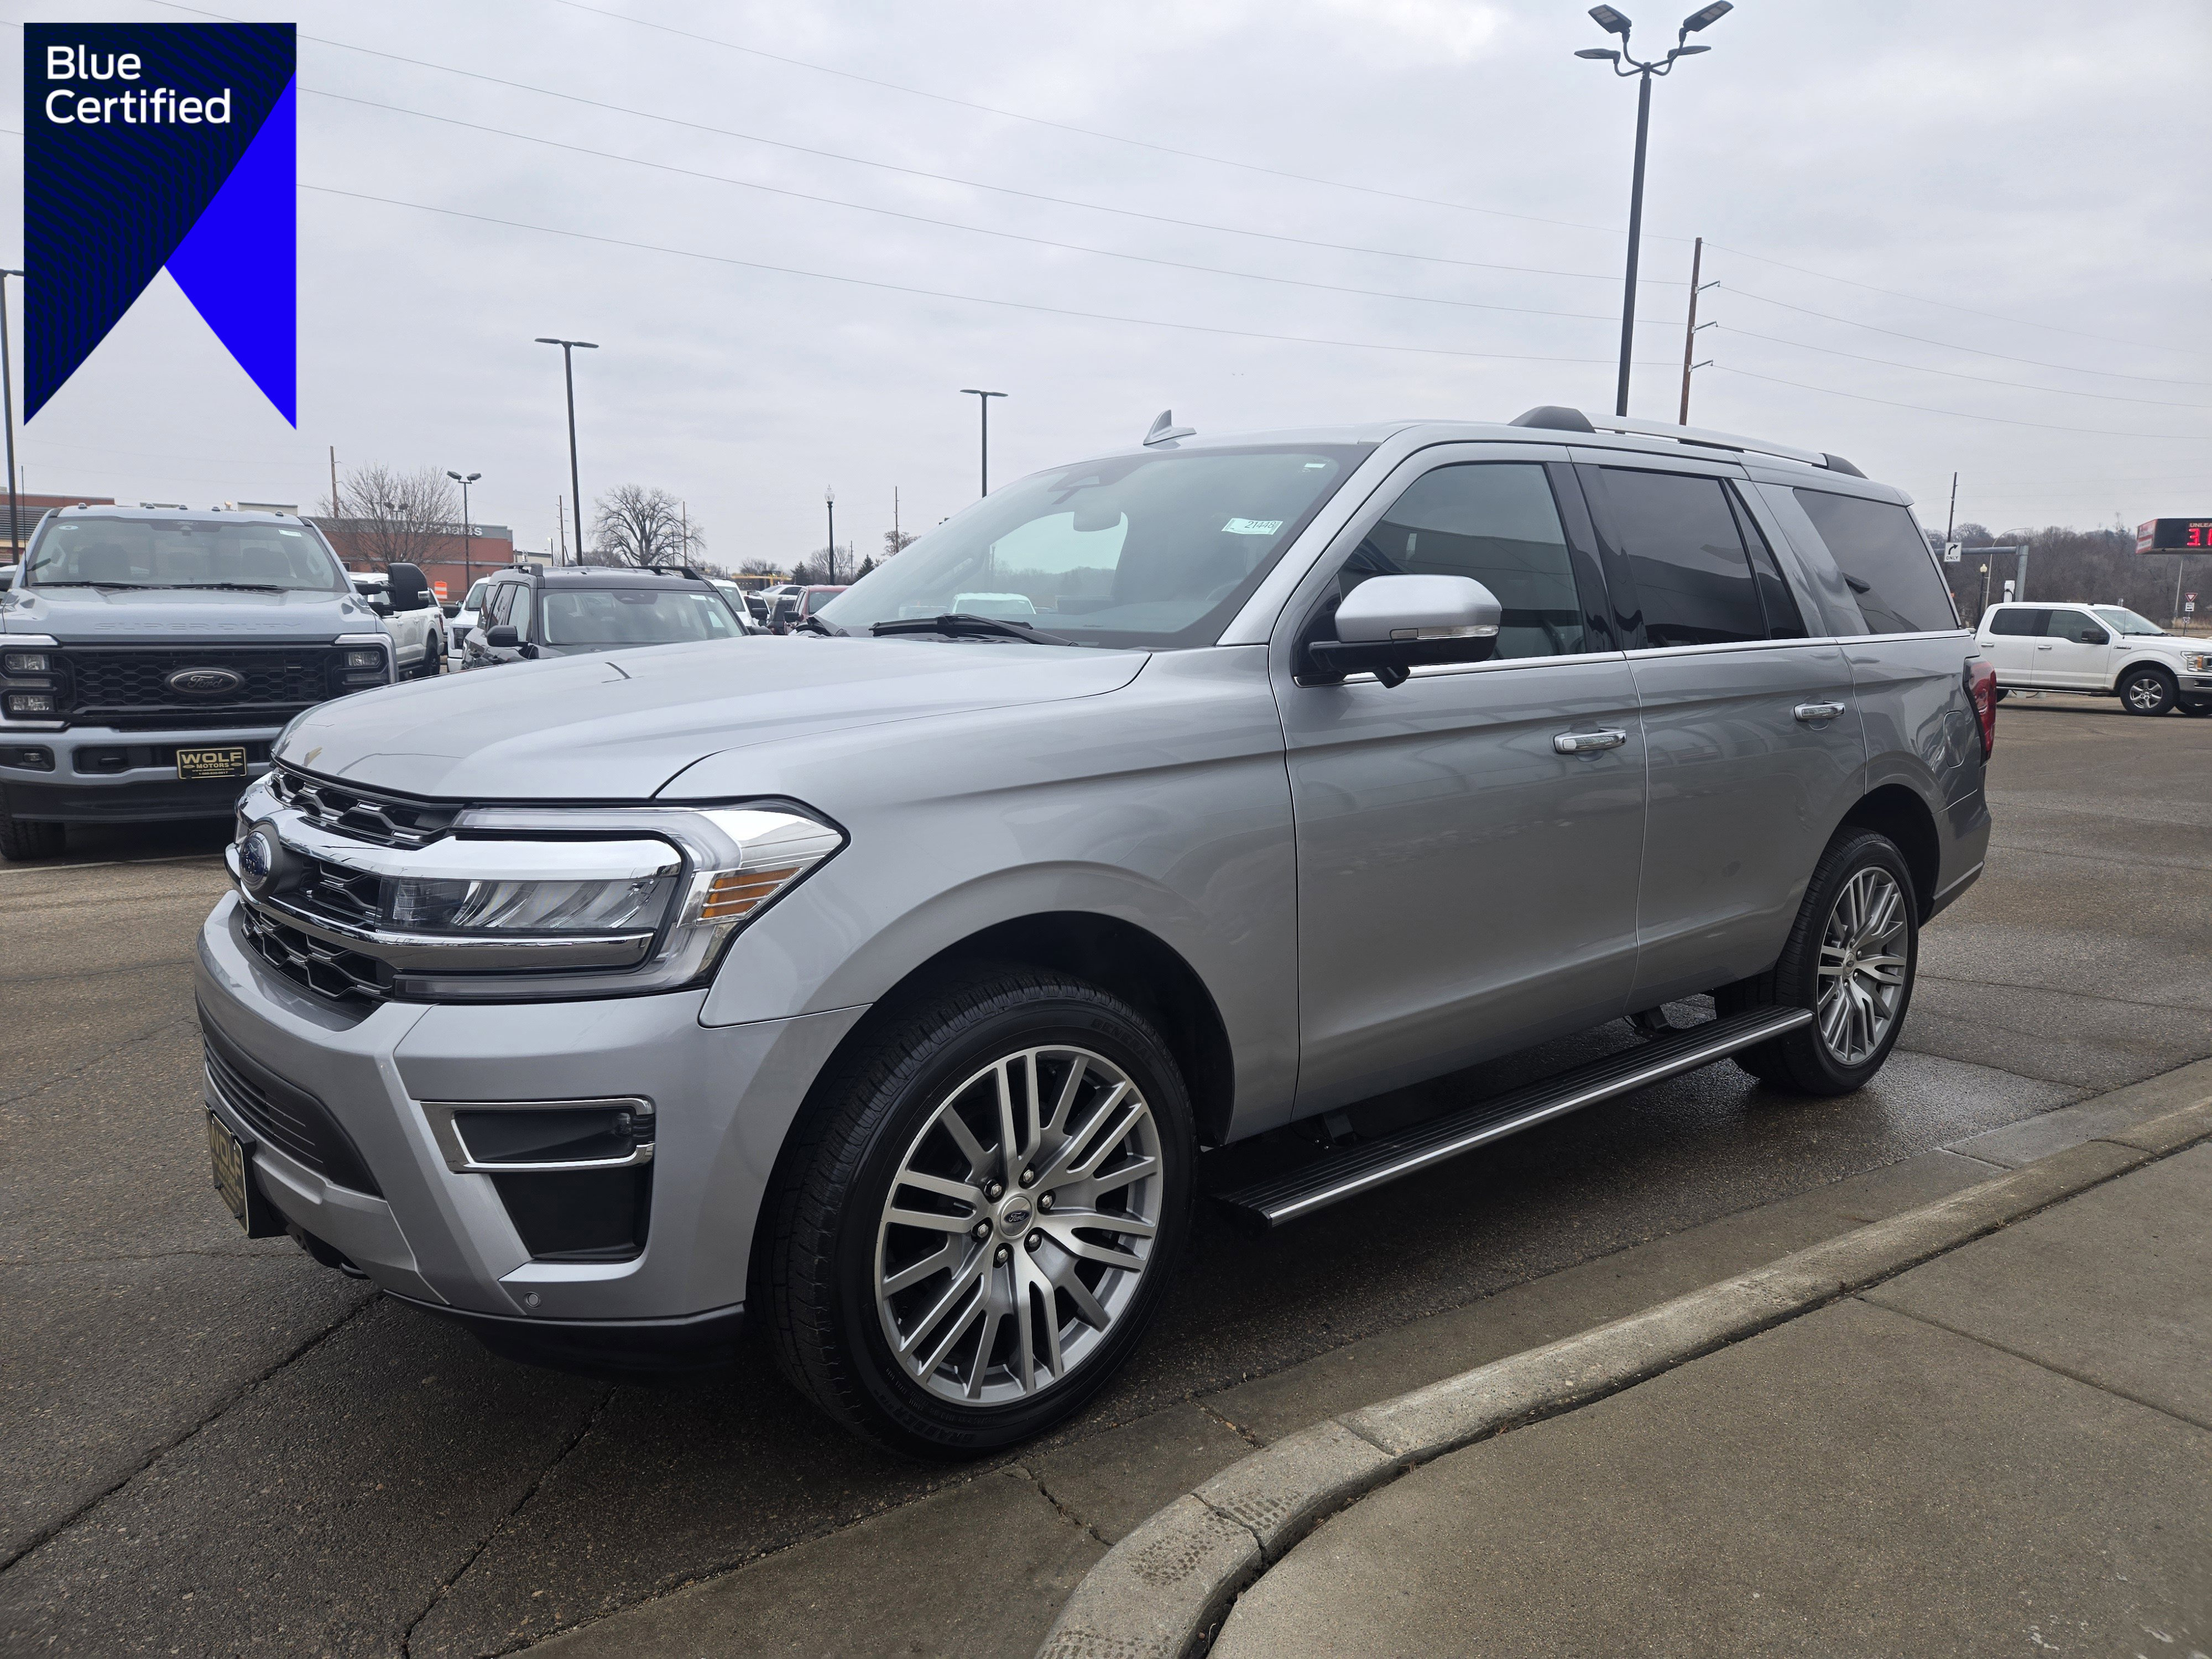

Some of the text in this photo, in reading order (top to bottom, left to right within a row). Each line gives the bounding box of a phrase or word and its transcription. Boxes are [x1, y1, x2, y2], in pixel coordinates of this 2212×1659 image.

[187, 675, 223, 688] Ford
[181, 752, 242, 764] WOLF
[1091, 1019, 1154, 1068] GENERAL
[1009, 1212, 1026, 1222] Ford
